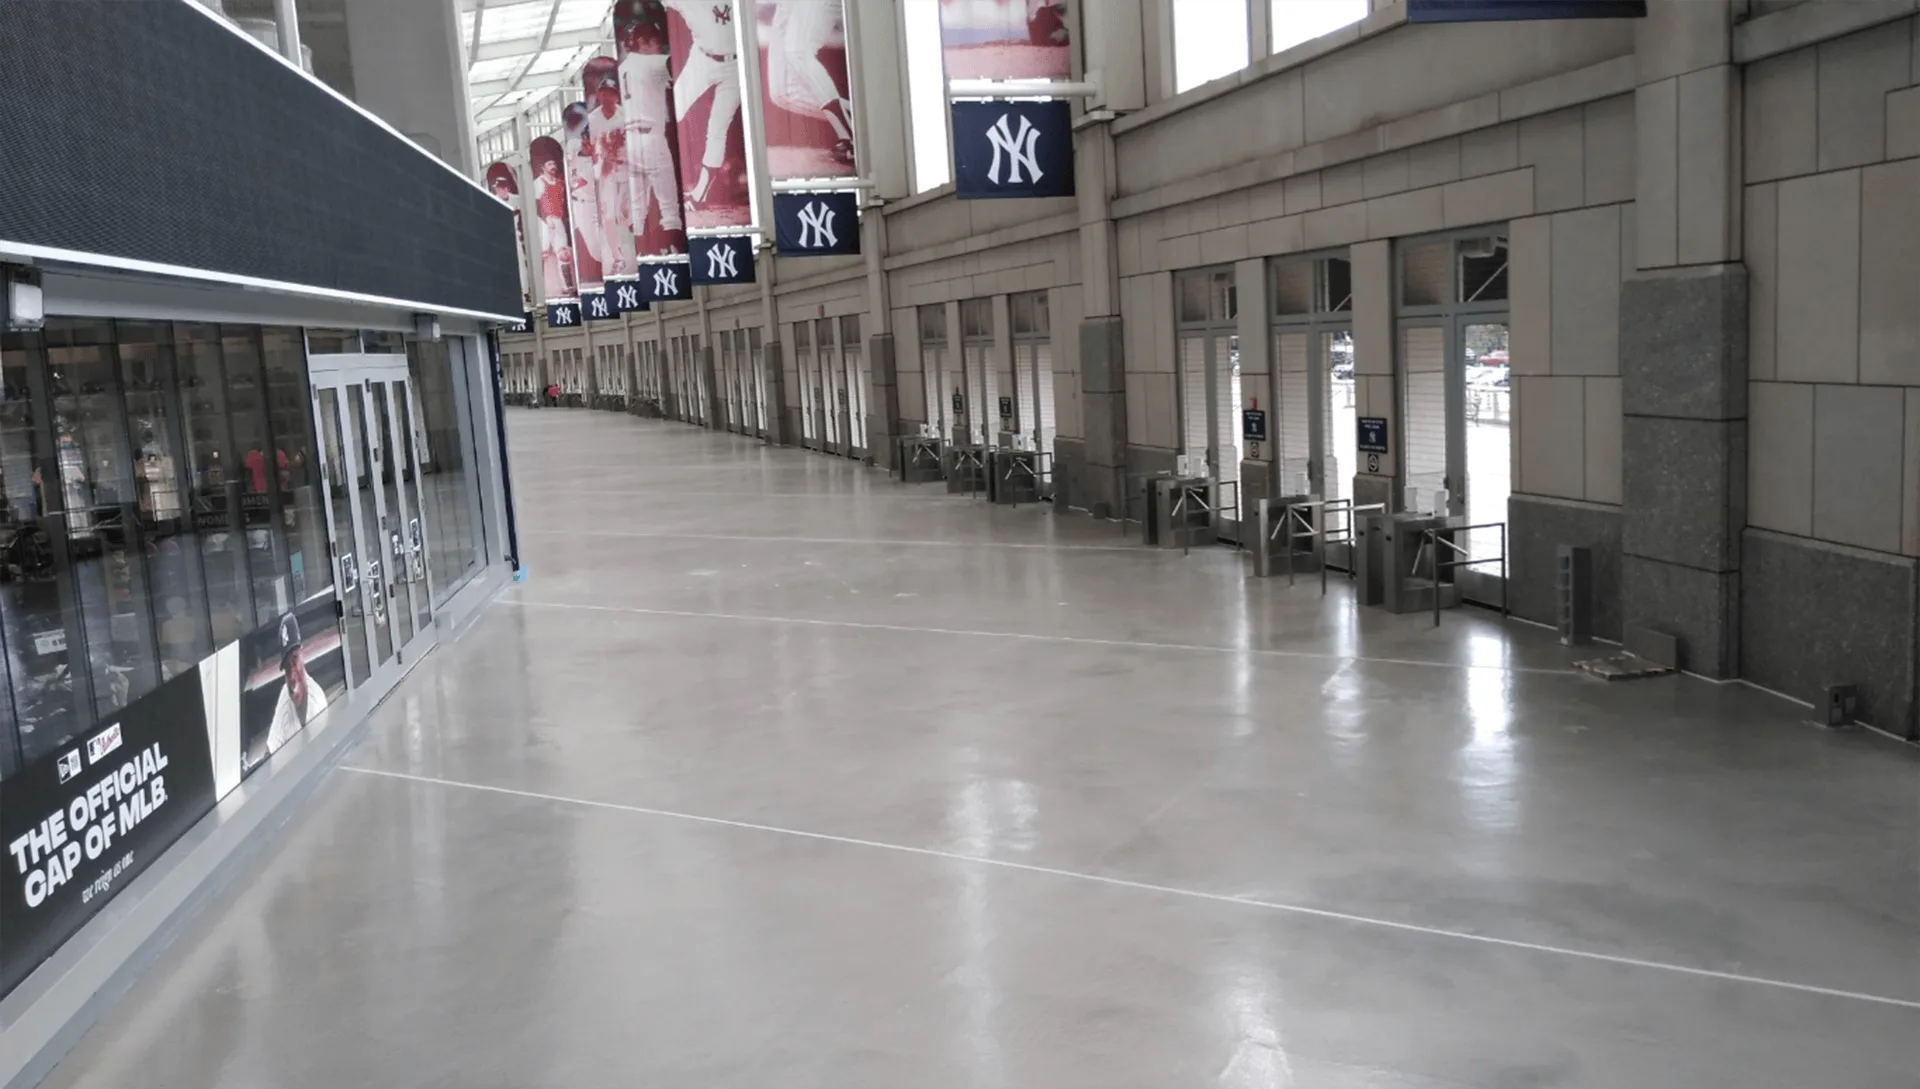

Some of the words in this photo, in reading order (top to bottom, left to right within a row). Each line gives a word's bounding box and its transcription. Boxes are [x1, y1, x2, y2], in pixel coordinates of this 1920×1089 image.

[985, 113, 1044, 185] NY
[797, 201, 838, 248] NY
[706, 243, 739, 279] NY
[616, 285, 638, 309] NY
[653, 268, 679, 296] NY
[555, 306, 573, 325] NY
[9, 808, 68, 875] THE
[69, 741, 169, 832] OFFICIAL
[24, 840, 82, 908] CAP
[85, 811, 117, 861] OF
[94, 868, 113, 894] reign
